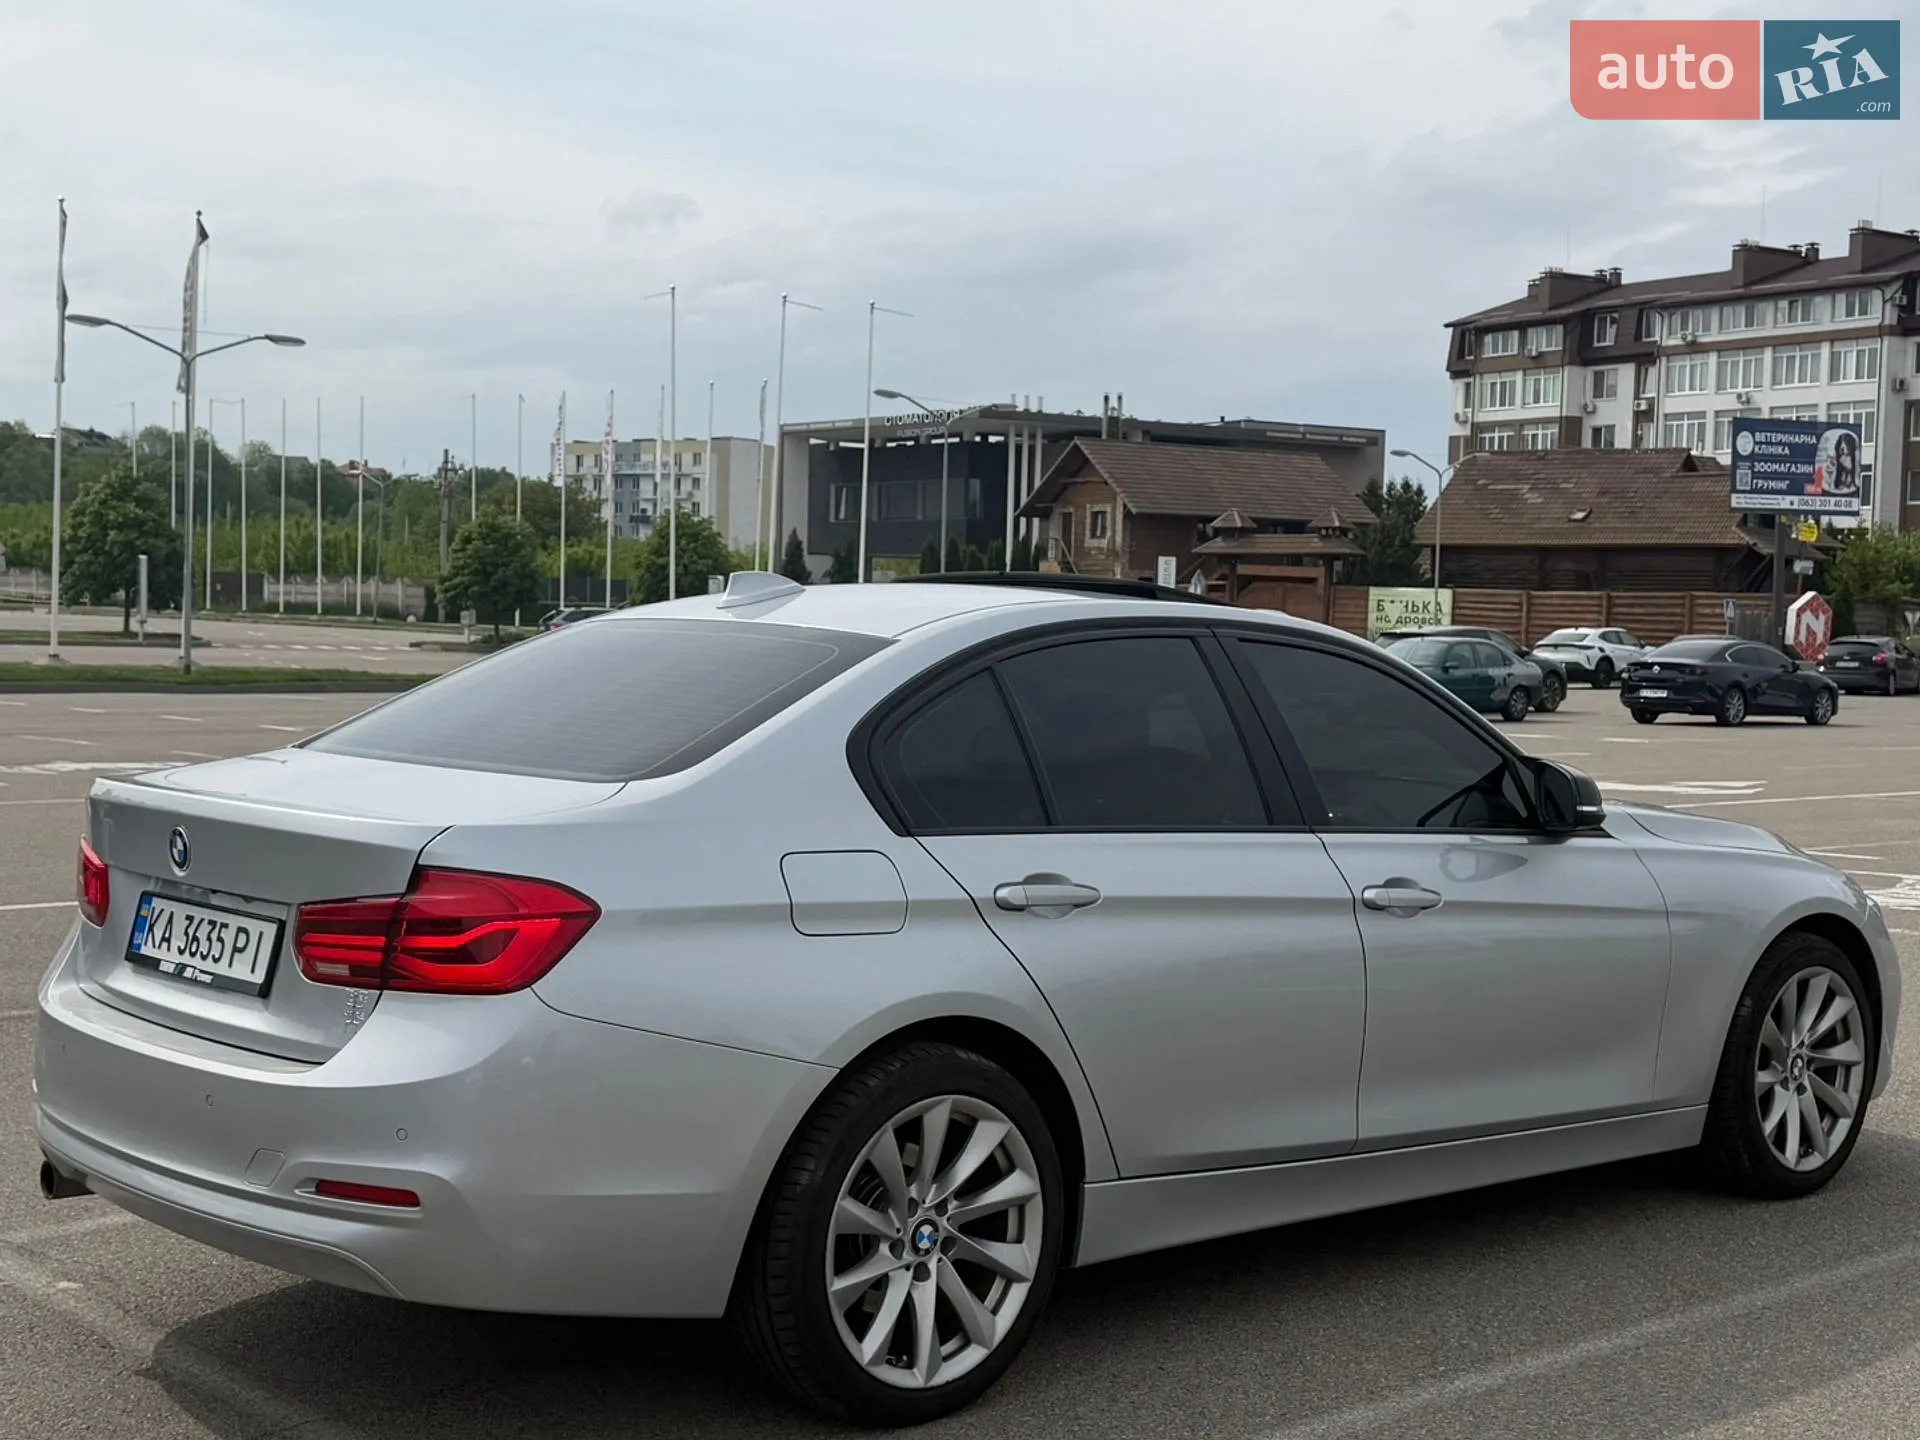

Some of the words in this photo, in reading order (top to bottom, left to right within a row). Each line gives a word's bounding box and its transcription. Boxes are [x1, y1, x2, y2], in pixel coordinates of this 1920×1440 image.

[1754, 431, 1817, 444] ВЕТЕРИНАРНА
[1754, 444, 1790, 456] КЛІНІКА
[1753, 461, 1814, 474] ЗООМАГАЗИН
[1752, 479, 1790, 490] ГРУМІНГ
[1376, 599, 1443, 614] БНЬКА
[144, 906, 175, 952] KA
[177, 914, 230, 964] 3635
[228, 926, 264, 974] PI
